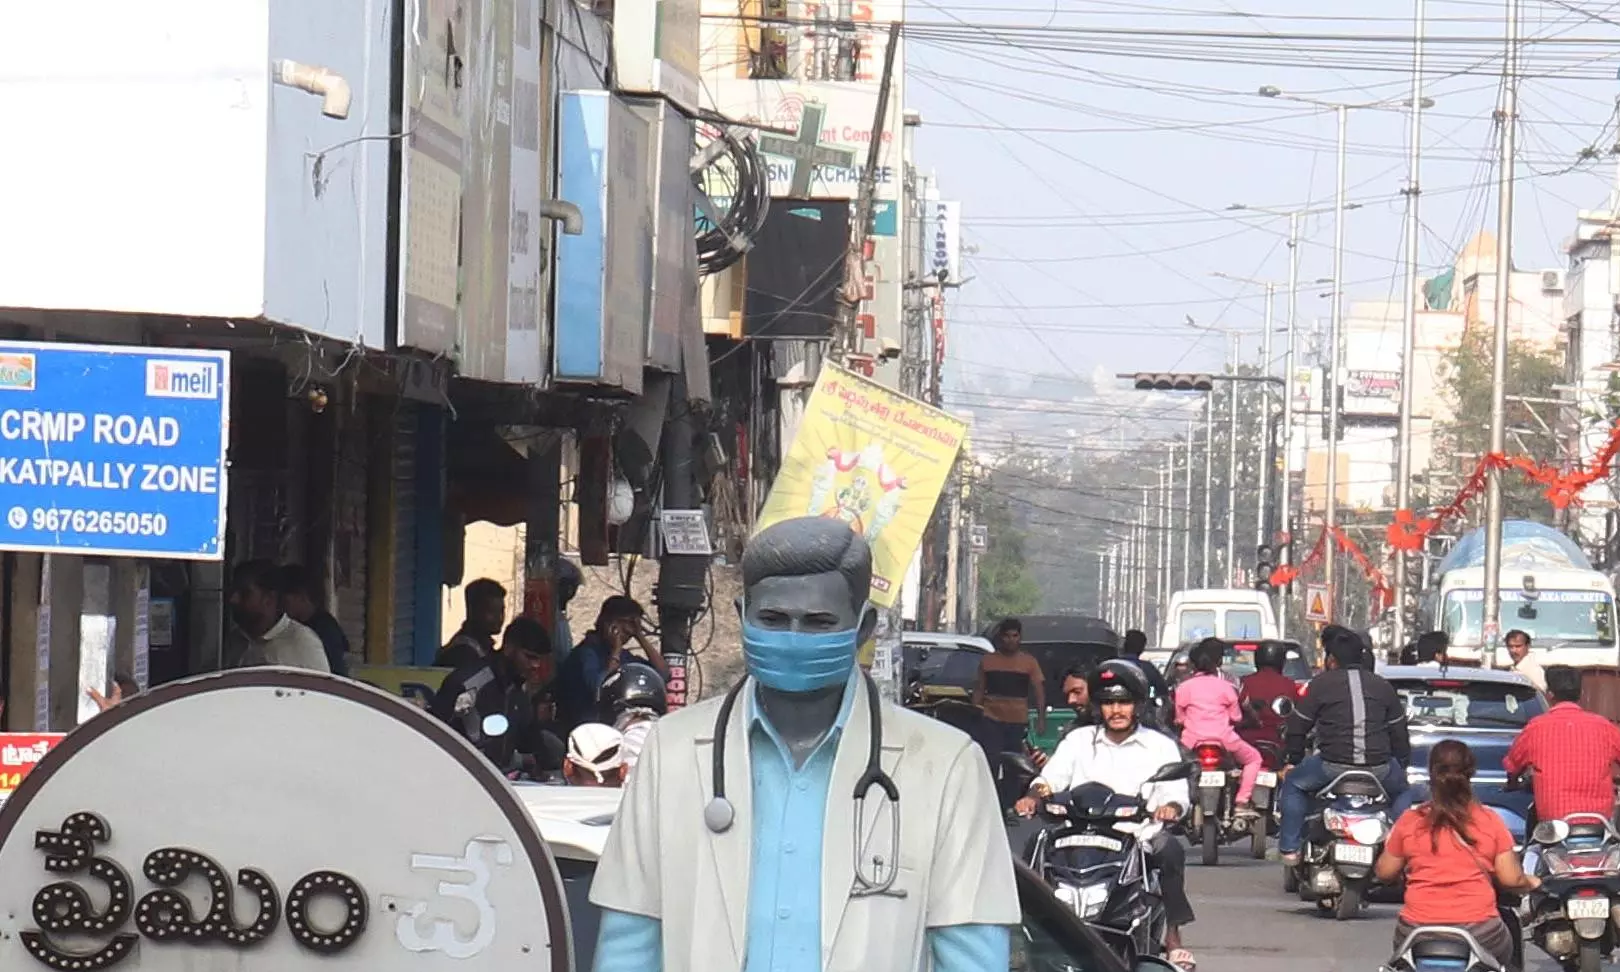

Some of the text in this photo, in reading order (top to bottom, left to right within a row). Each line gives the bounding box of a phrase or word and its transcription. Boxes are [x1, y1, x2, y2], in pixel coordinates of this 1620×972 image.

[171, 366, 214, 396] meil
[1, 409, 180, 447] CRMP ROAD
[140, 464, 217, 494] ZONE
[32, 508, 168, 536] 9676265050
